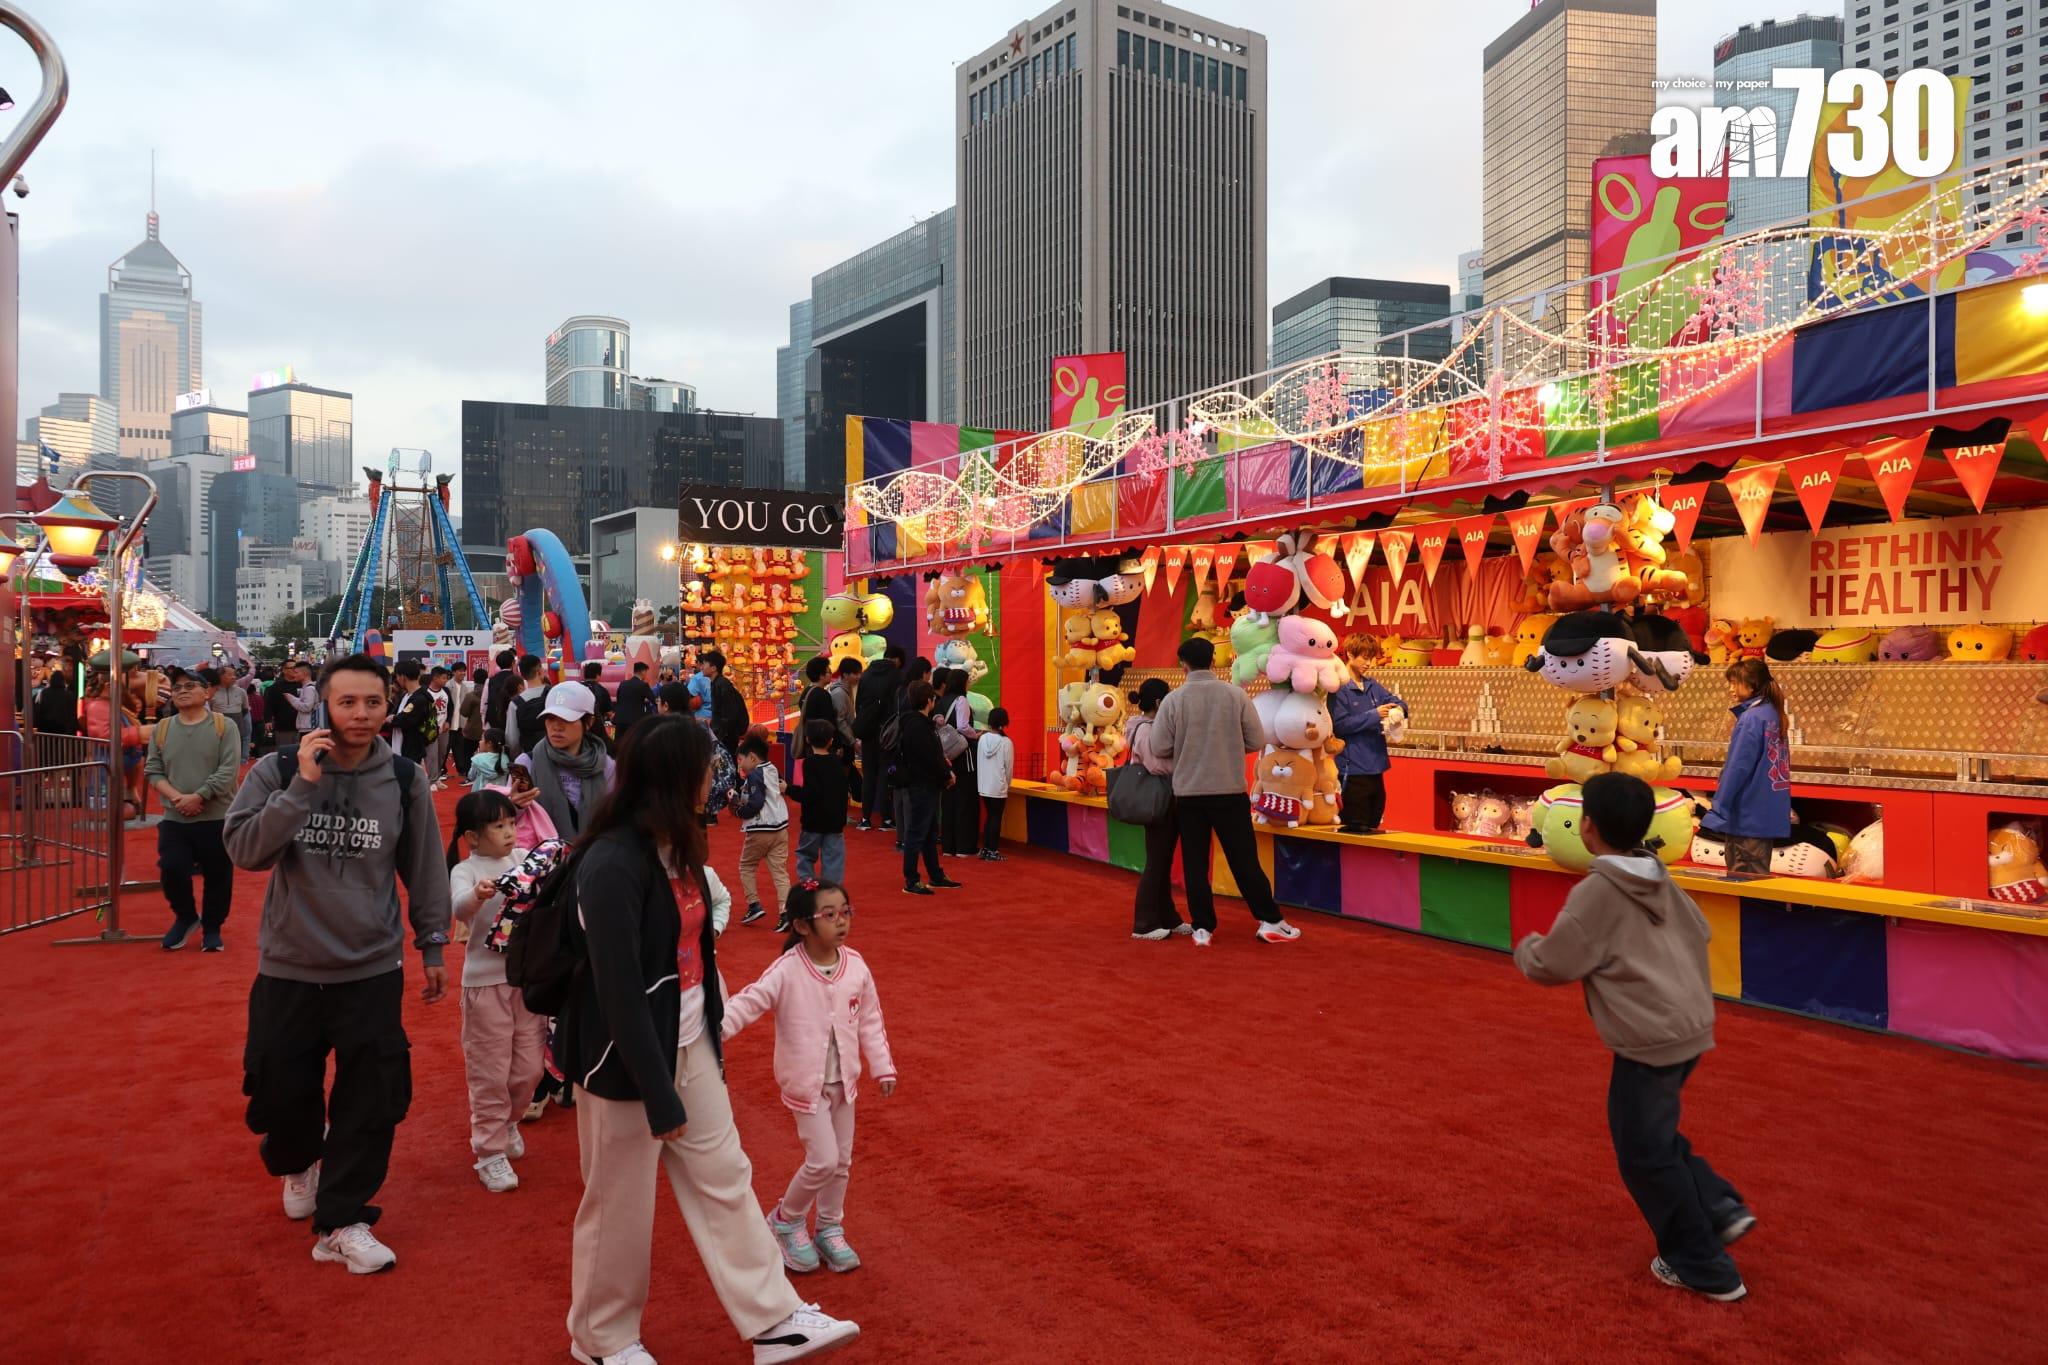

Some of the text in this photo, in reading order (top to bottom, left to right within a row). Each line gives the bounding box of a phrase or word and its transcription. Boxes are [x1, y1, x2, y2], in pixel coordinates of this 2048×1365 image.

[1878, 456, 1912, 476] AIA
[1800, 470, 1832, 489] AIA
[1739, 487, 1767, 502] AIA
[1671, 496, 1697, 512] AIA
[691, 497, 833, 535] YOU GO
[1464, 530, 1484, 543] AIA
[1518, 523, 1538, 537] AIA
[1423, 536, 1443, 549] AIA
[1810, 525, 2003, 572] RETHINK
[1168, 558, 1181, 567] AIA
[1195, 558, 1209, 566] AIA
[1218, 555, 1233, 565] AIA
[1810, 565, 2003, 617] HEALTHY
[1345, 579, 1428, 627] AIA
[442, 635, 474, 646] TVB
